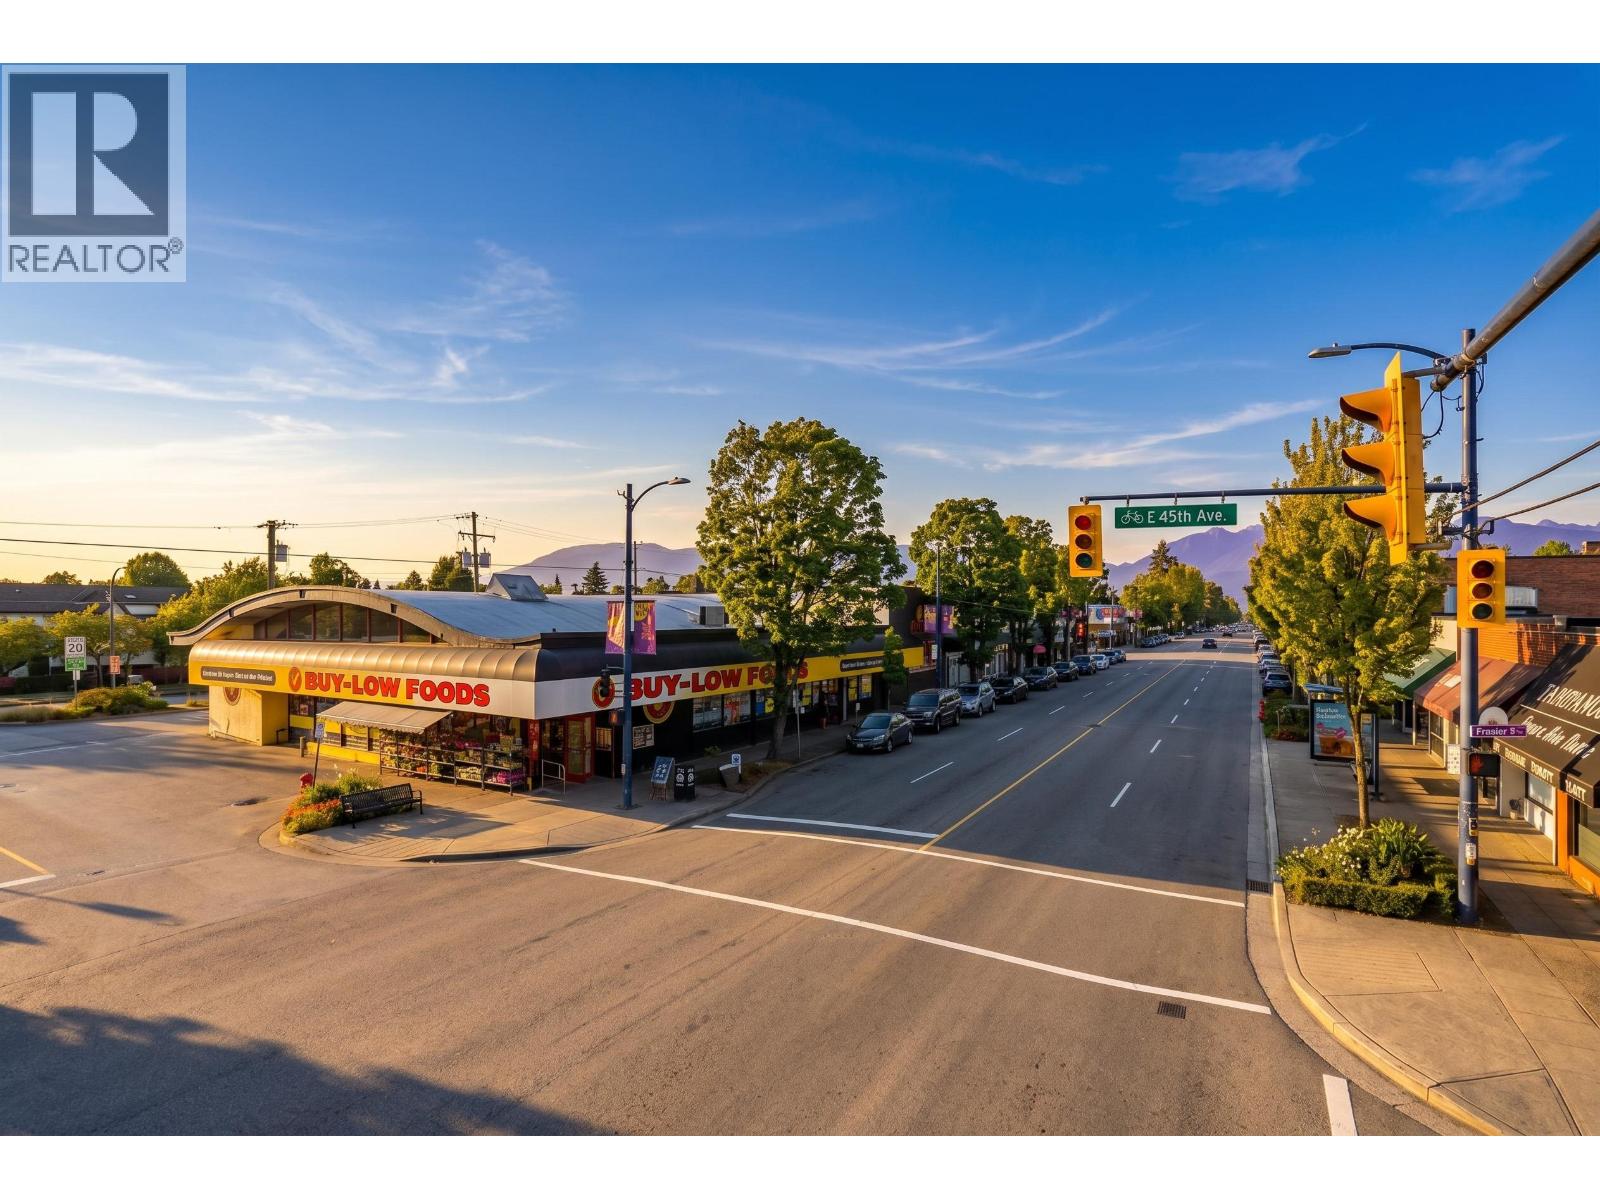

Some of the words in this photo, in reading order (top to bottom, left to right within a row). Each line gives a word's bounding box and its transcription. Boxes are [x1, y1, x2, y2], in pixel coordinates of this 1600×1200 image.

[1147, 511, 1156, 524] E
[1160, 510, 1191, 523] 45th
[1197, 509, 1227, 522] Ave.
[68, 643, 83, 653] 20
[304, 671, 401, 698] BUY-LOW
[406, 678, 491, 707] FOODS
[1476, 727, 1508, 736] Frasier
